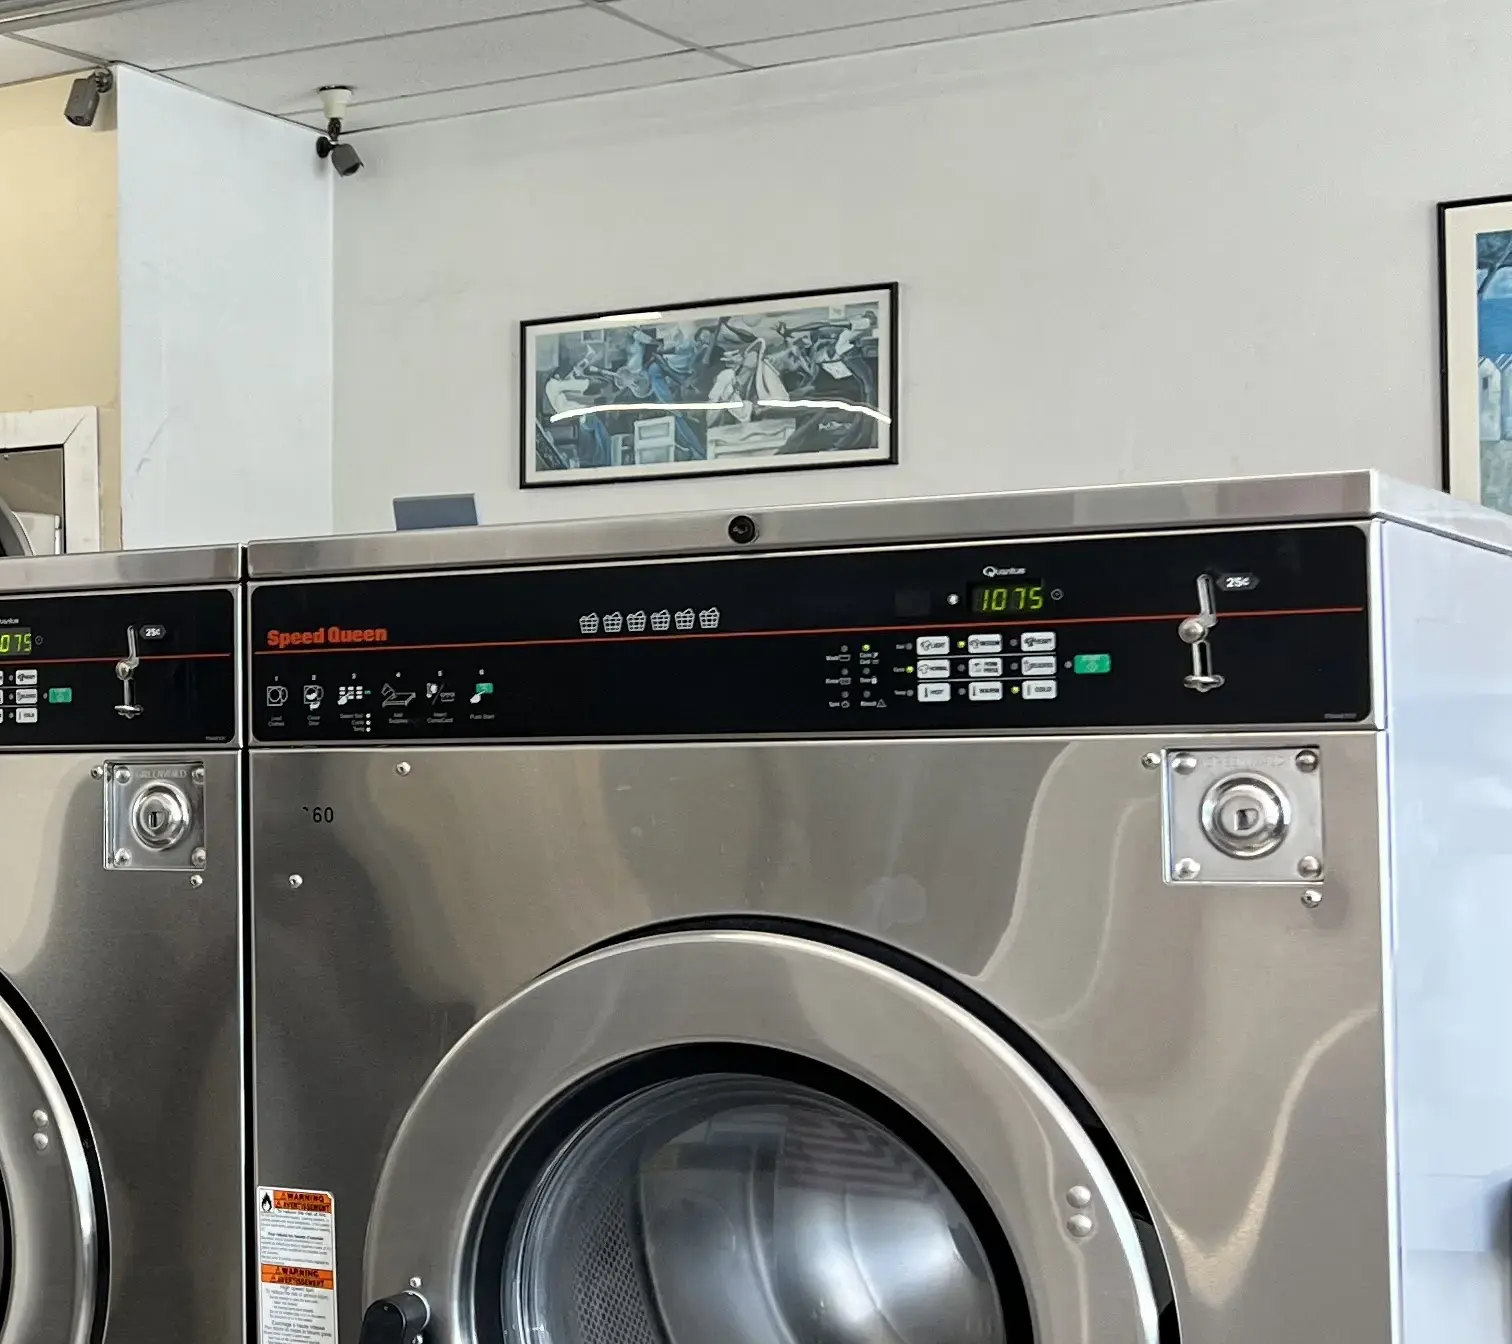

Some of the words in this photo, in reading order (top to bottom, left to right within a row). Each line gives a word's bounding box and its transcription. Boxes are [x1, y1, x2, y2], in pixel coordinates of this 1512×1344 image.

[267, 627, 325, 648] Speed
[327, 626, 387, 643] Queen
[302, 806, 334, 823] 60
[287, 1192, 325, 1203] WARNING
[281, 1267, 320, 1277] WARNING
